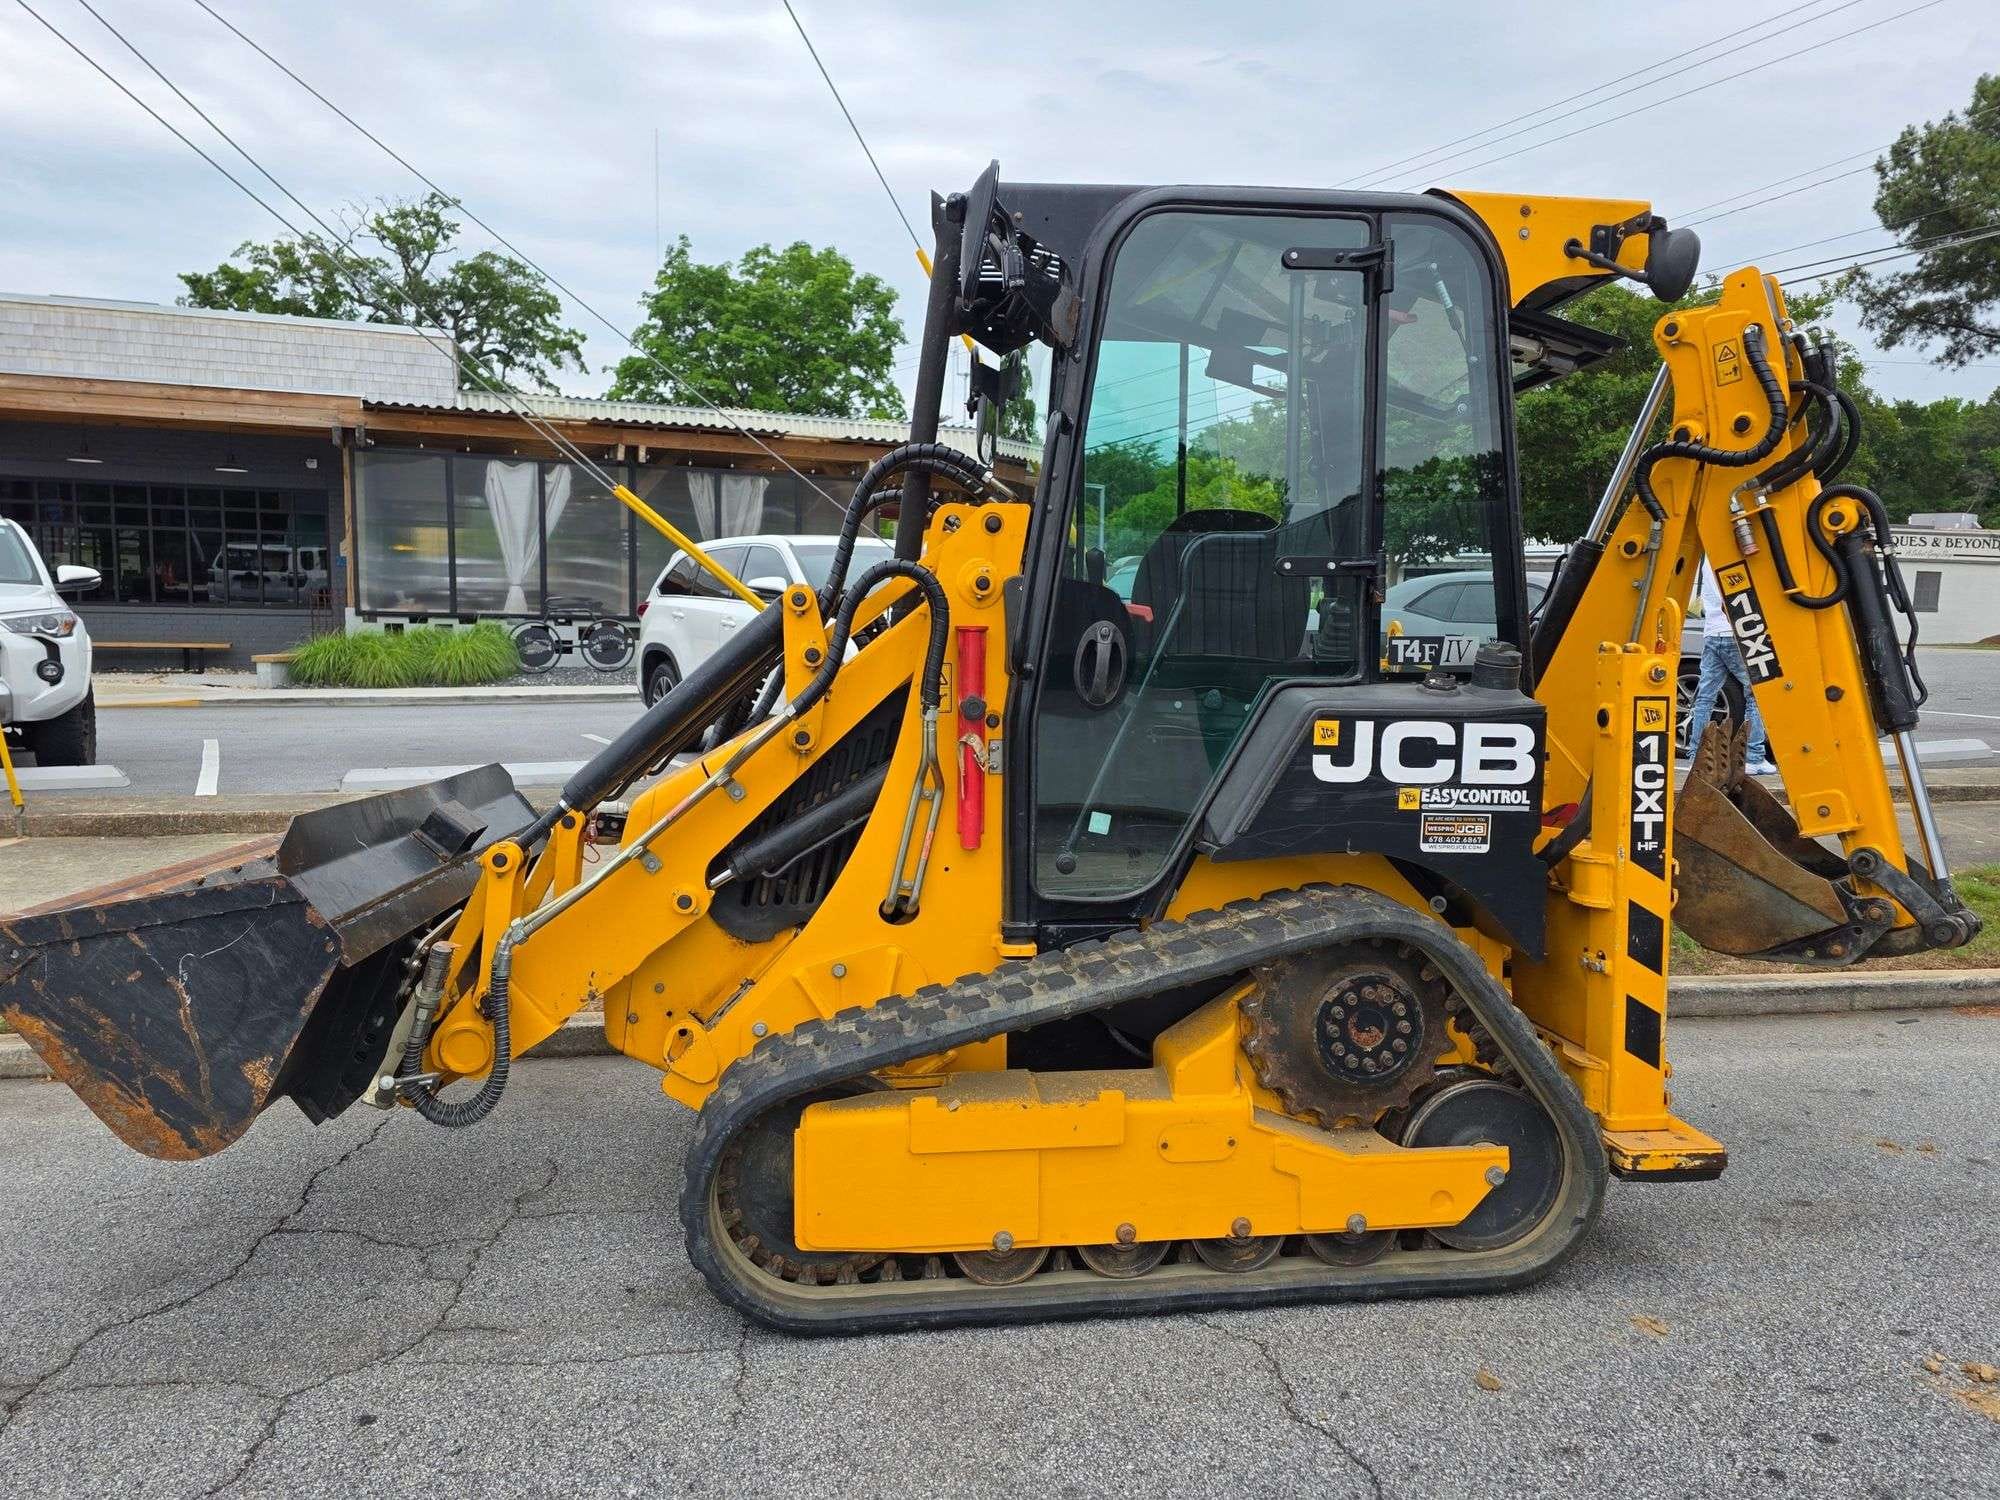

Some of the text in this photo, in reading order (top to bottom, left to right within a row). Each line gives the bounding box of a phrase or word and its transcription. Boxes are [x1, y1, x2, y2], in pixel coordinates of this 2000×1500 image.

[1932, 537, 1940, 547] &
[1730, 593, 1775, 677] 1CXT
[1642, 707, 1662, 724] JCB
[1312, 720, 1536, 785] JCB
[1633, 735, 1665, 840] 1CXT
[1457, 825, 1484, 833] JCB
[1637, 842, 1658, 851] HF
